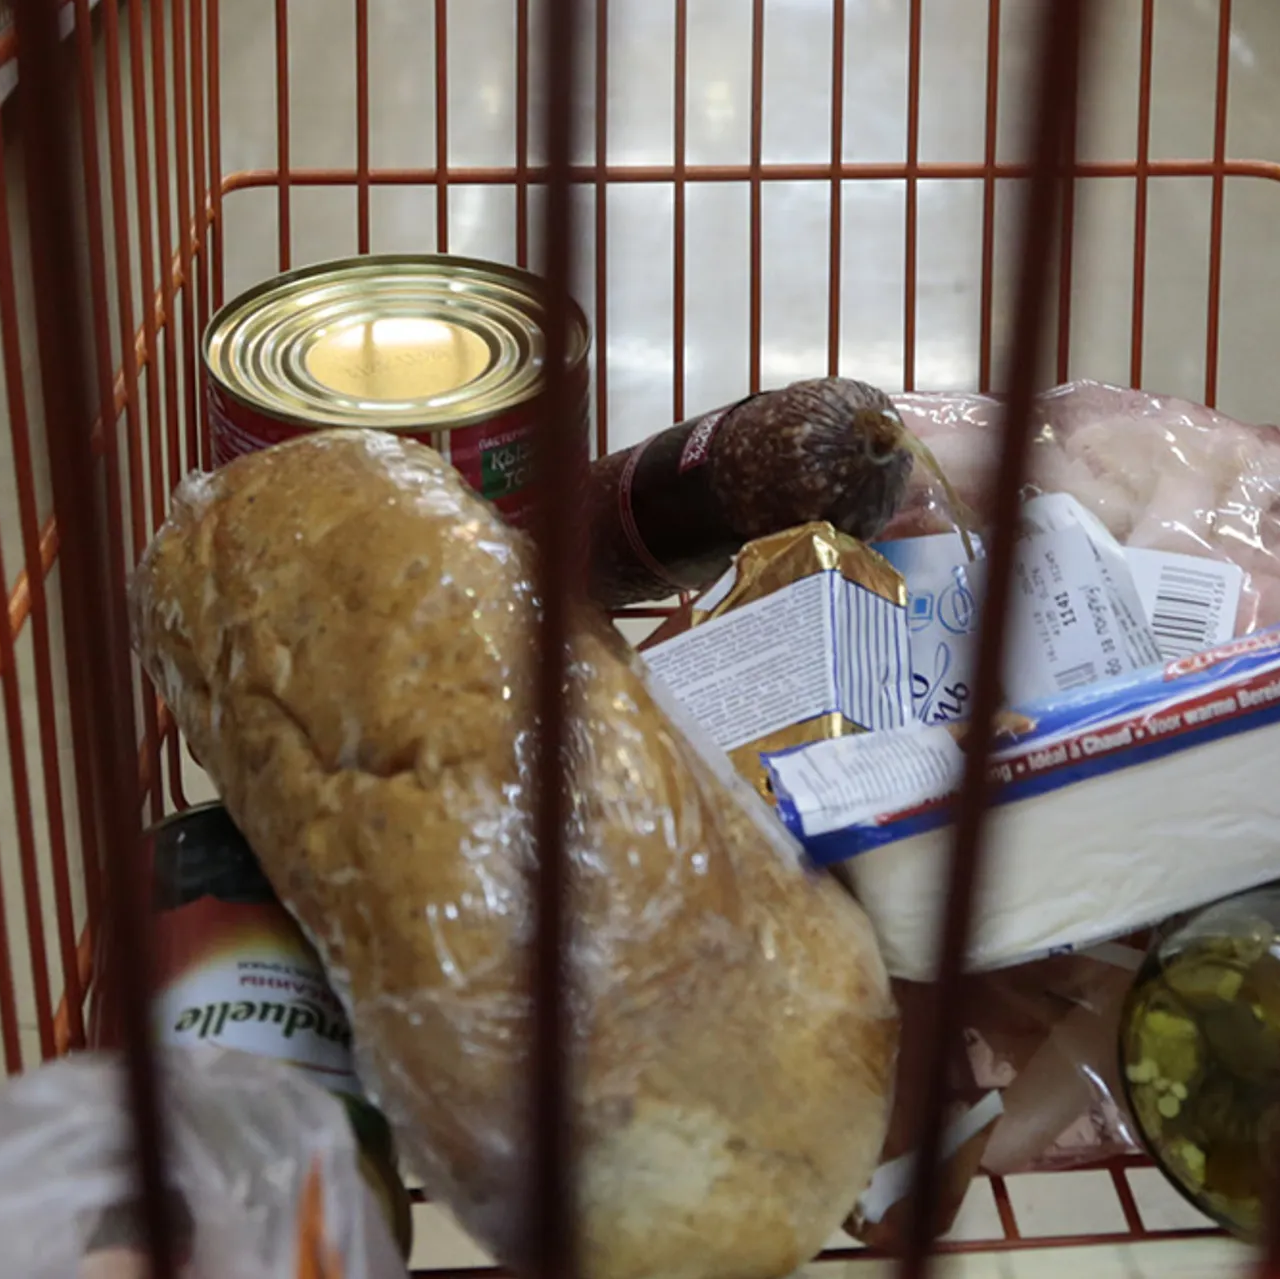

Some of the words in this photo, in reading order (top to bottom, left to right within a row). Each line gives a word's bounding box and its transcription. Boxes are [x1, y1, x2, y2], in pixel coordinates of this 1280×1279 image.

[1054, 591, 1077, 627] 1141
[1027, 747, 1068, 773] Idéal
[1082, 724, 1133, 755] Chaud
[1185, 694, 1237, 725] warme
[174, 1000, 352, 1050] nduelle
